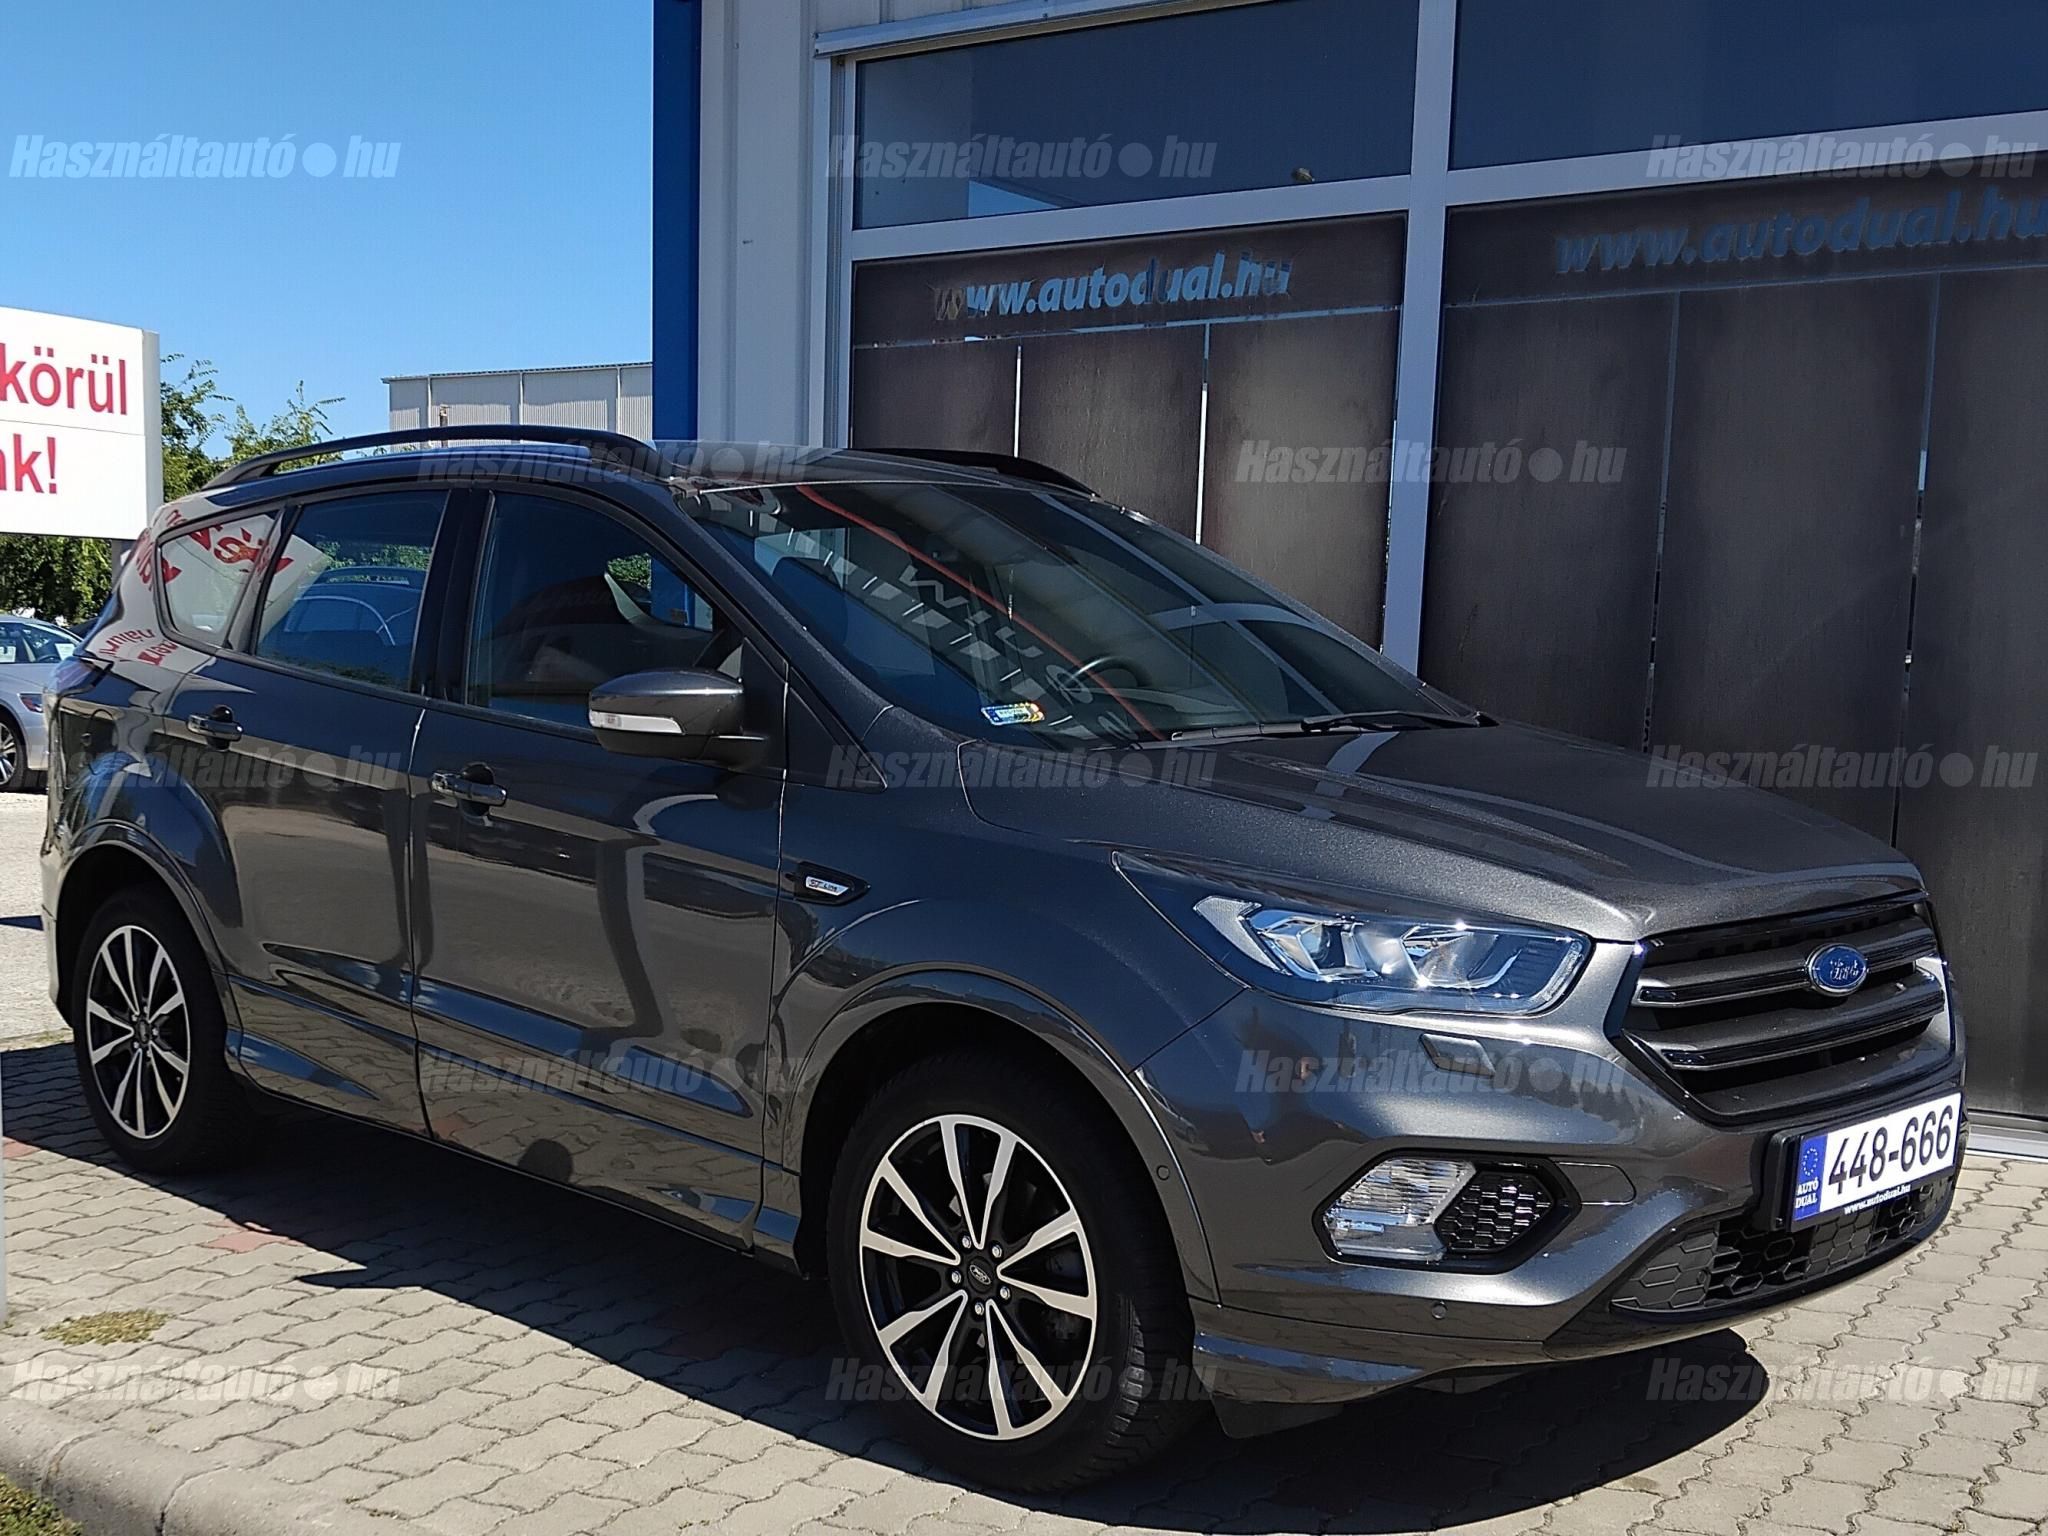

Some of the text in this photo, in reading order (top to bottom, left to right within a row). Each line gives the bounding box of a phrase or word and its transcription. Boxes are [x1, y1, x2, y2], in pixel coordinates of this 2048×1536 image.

[933, 250, 1292, 321] www.autodual.hu
[1828, 1104, 1953, 1195] 448-666
[1795, 1192, 1818, 1208] DUAL
